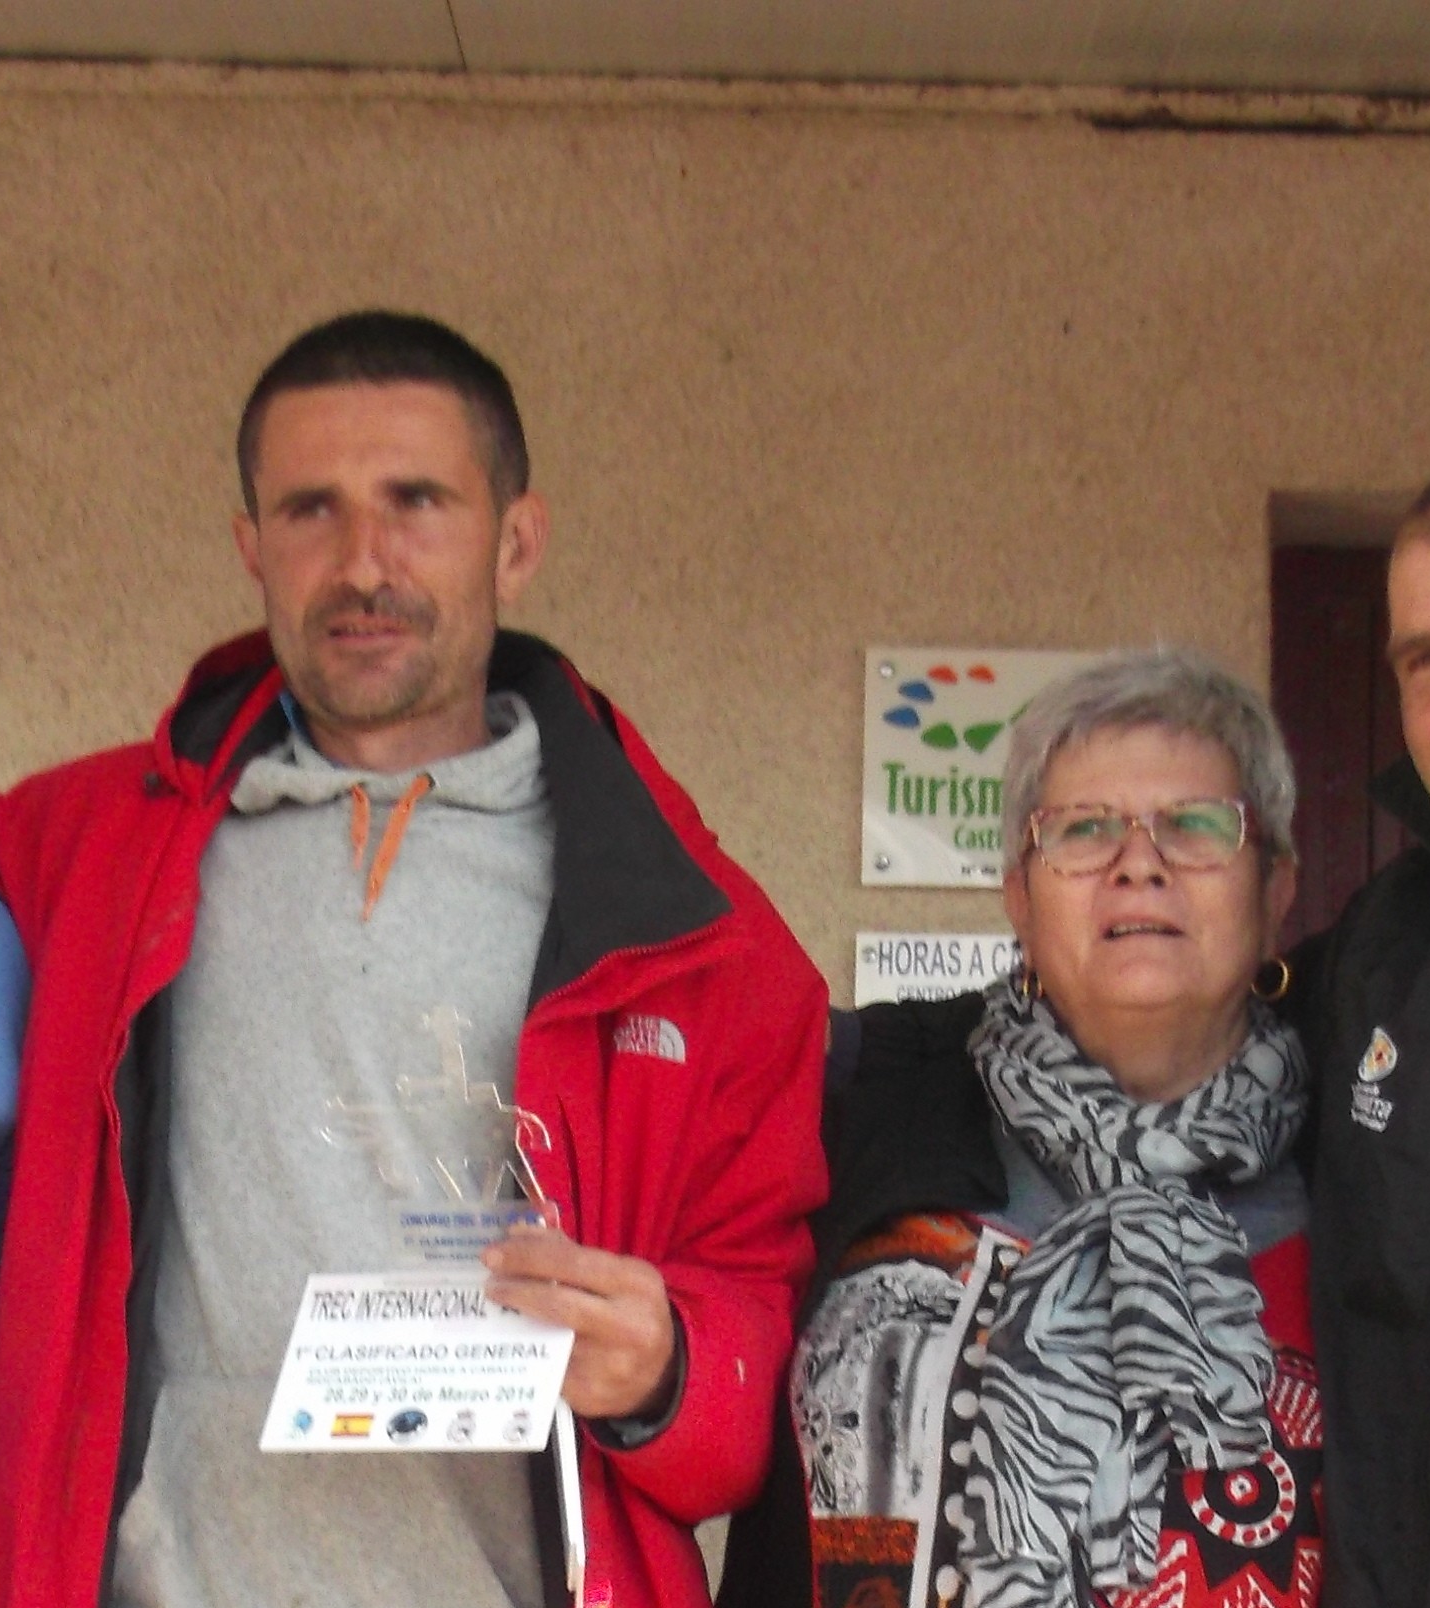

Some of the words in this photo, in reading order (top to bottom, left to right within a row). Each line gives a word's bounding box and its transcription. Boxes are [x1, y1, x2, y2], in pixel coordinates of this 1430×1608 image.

[878, 940, 962, 976] HORAS
[968, 940, 984, 976] A
[310, 1289, 356, 1321] TREC
[314, 1342, 449, 1361] CLASIFICADO
[454, 1342, 551, 1361] GENERAL
[438, 1385, 490, 1403] Marzo
[494, 1384, 537, 1402] 2014
